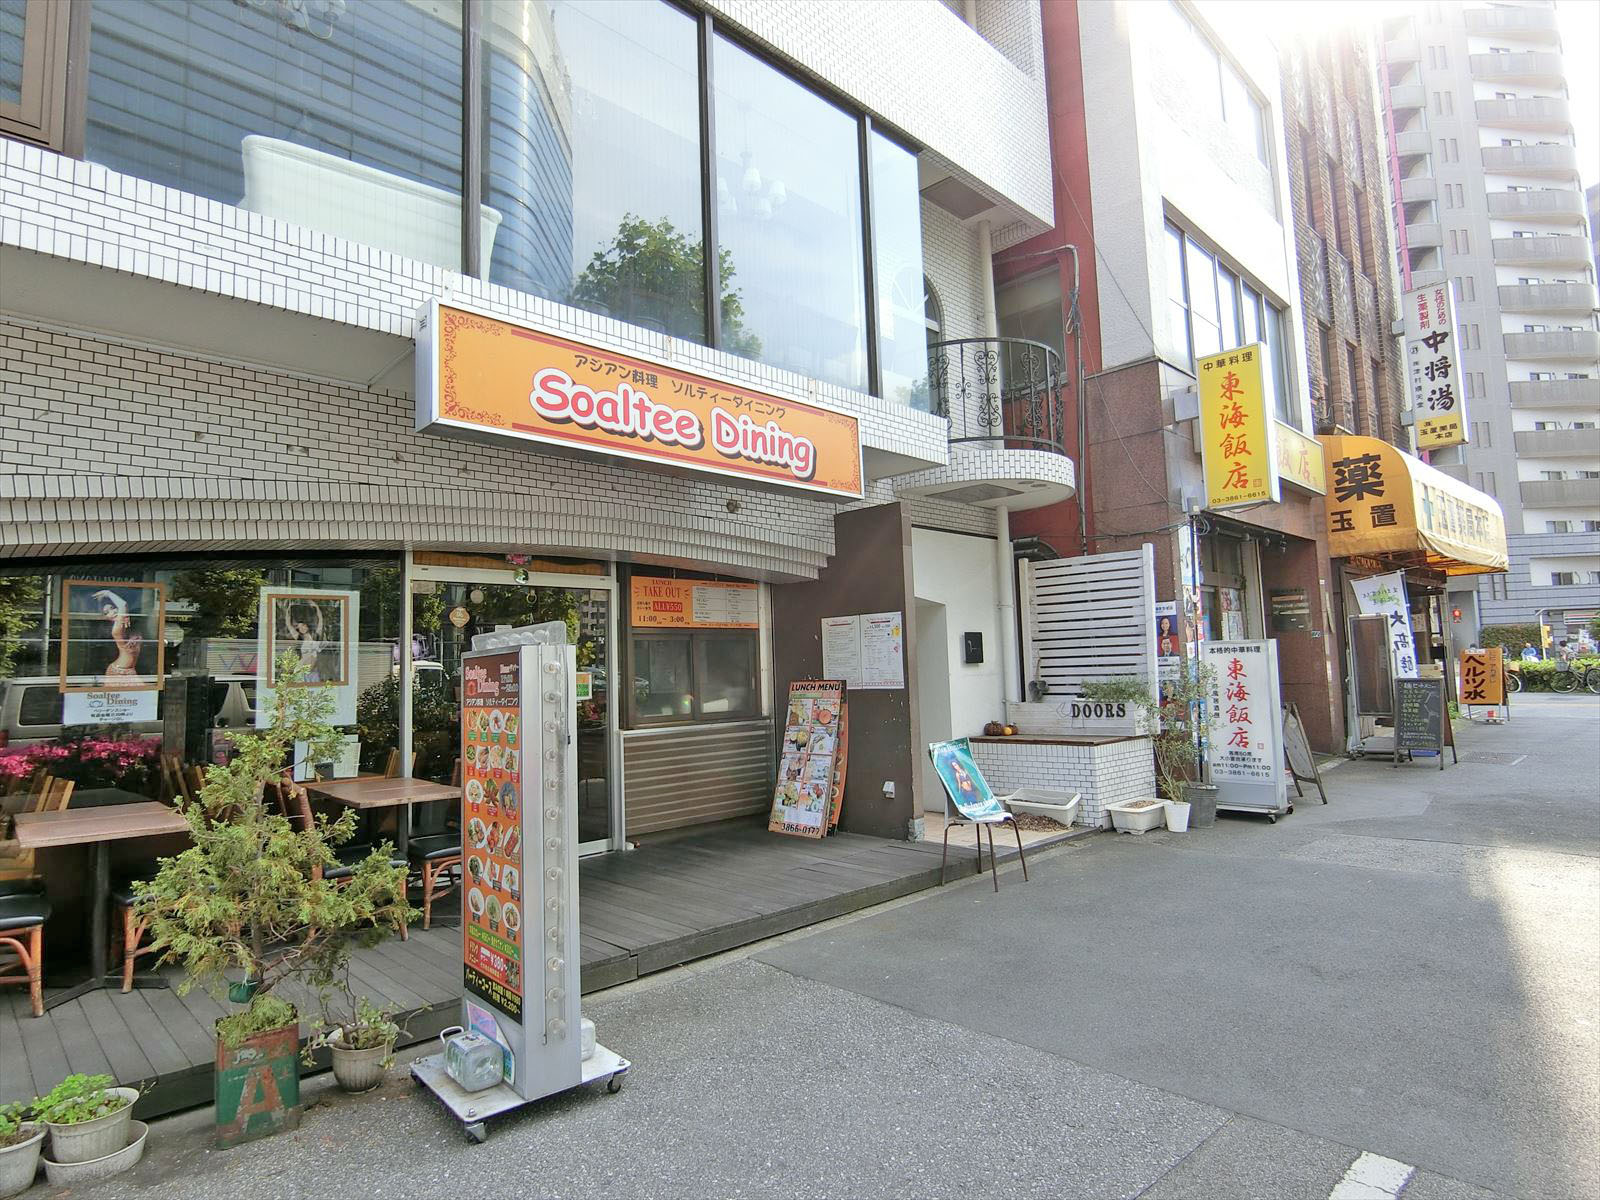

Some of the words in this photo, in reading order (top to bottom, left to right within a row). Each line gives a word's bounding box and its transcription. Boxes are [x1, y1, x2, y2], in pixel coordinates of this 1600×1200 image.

[1416, 293, 1430, 330] 生薬製剤
[1203, 351, 1253, 372] 中華料理
[1422, 330, 1455, 412] 中将湯
[574, 354, 659, 390] アジアン料理
[671, 380, 787, 420] ソルティーダイニング
[533, 370, 700, 446] Soaltee
[713, 408, 814, 477] Dining
[1219, 371, 1252, 489] 東海飯店
[1435, 431, 1453, 440] 本店
[1332, 453, 1385, 503] 薬
[1331, 504, 1398, 533] 玉置
[643, 586, 664, 598] TAKE
[665, 587, 681, 598] OUT
[1208, 646, 1261, 655] 本格的中華料理
[791, 683, 816, 691] LUNCH
[818, 683, 841, 691] MENU
[1464, 655, 1487, 700] ベルツ水
[107, 698, 138, 706] Dining
[1071, 703, 1126, 718] DOORS
[1225, 657, 1253, 749] 東海飯店
[781, 823, 820, 836] 3866-0177
